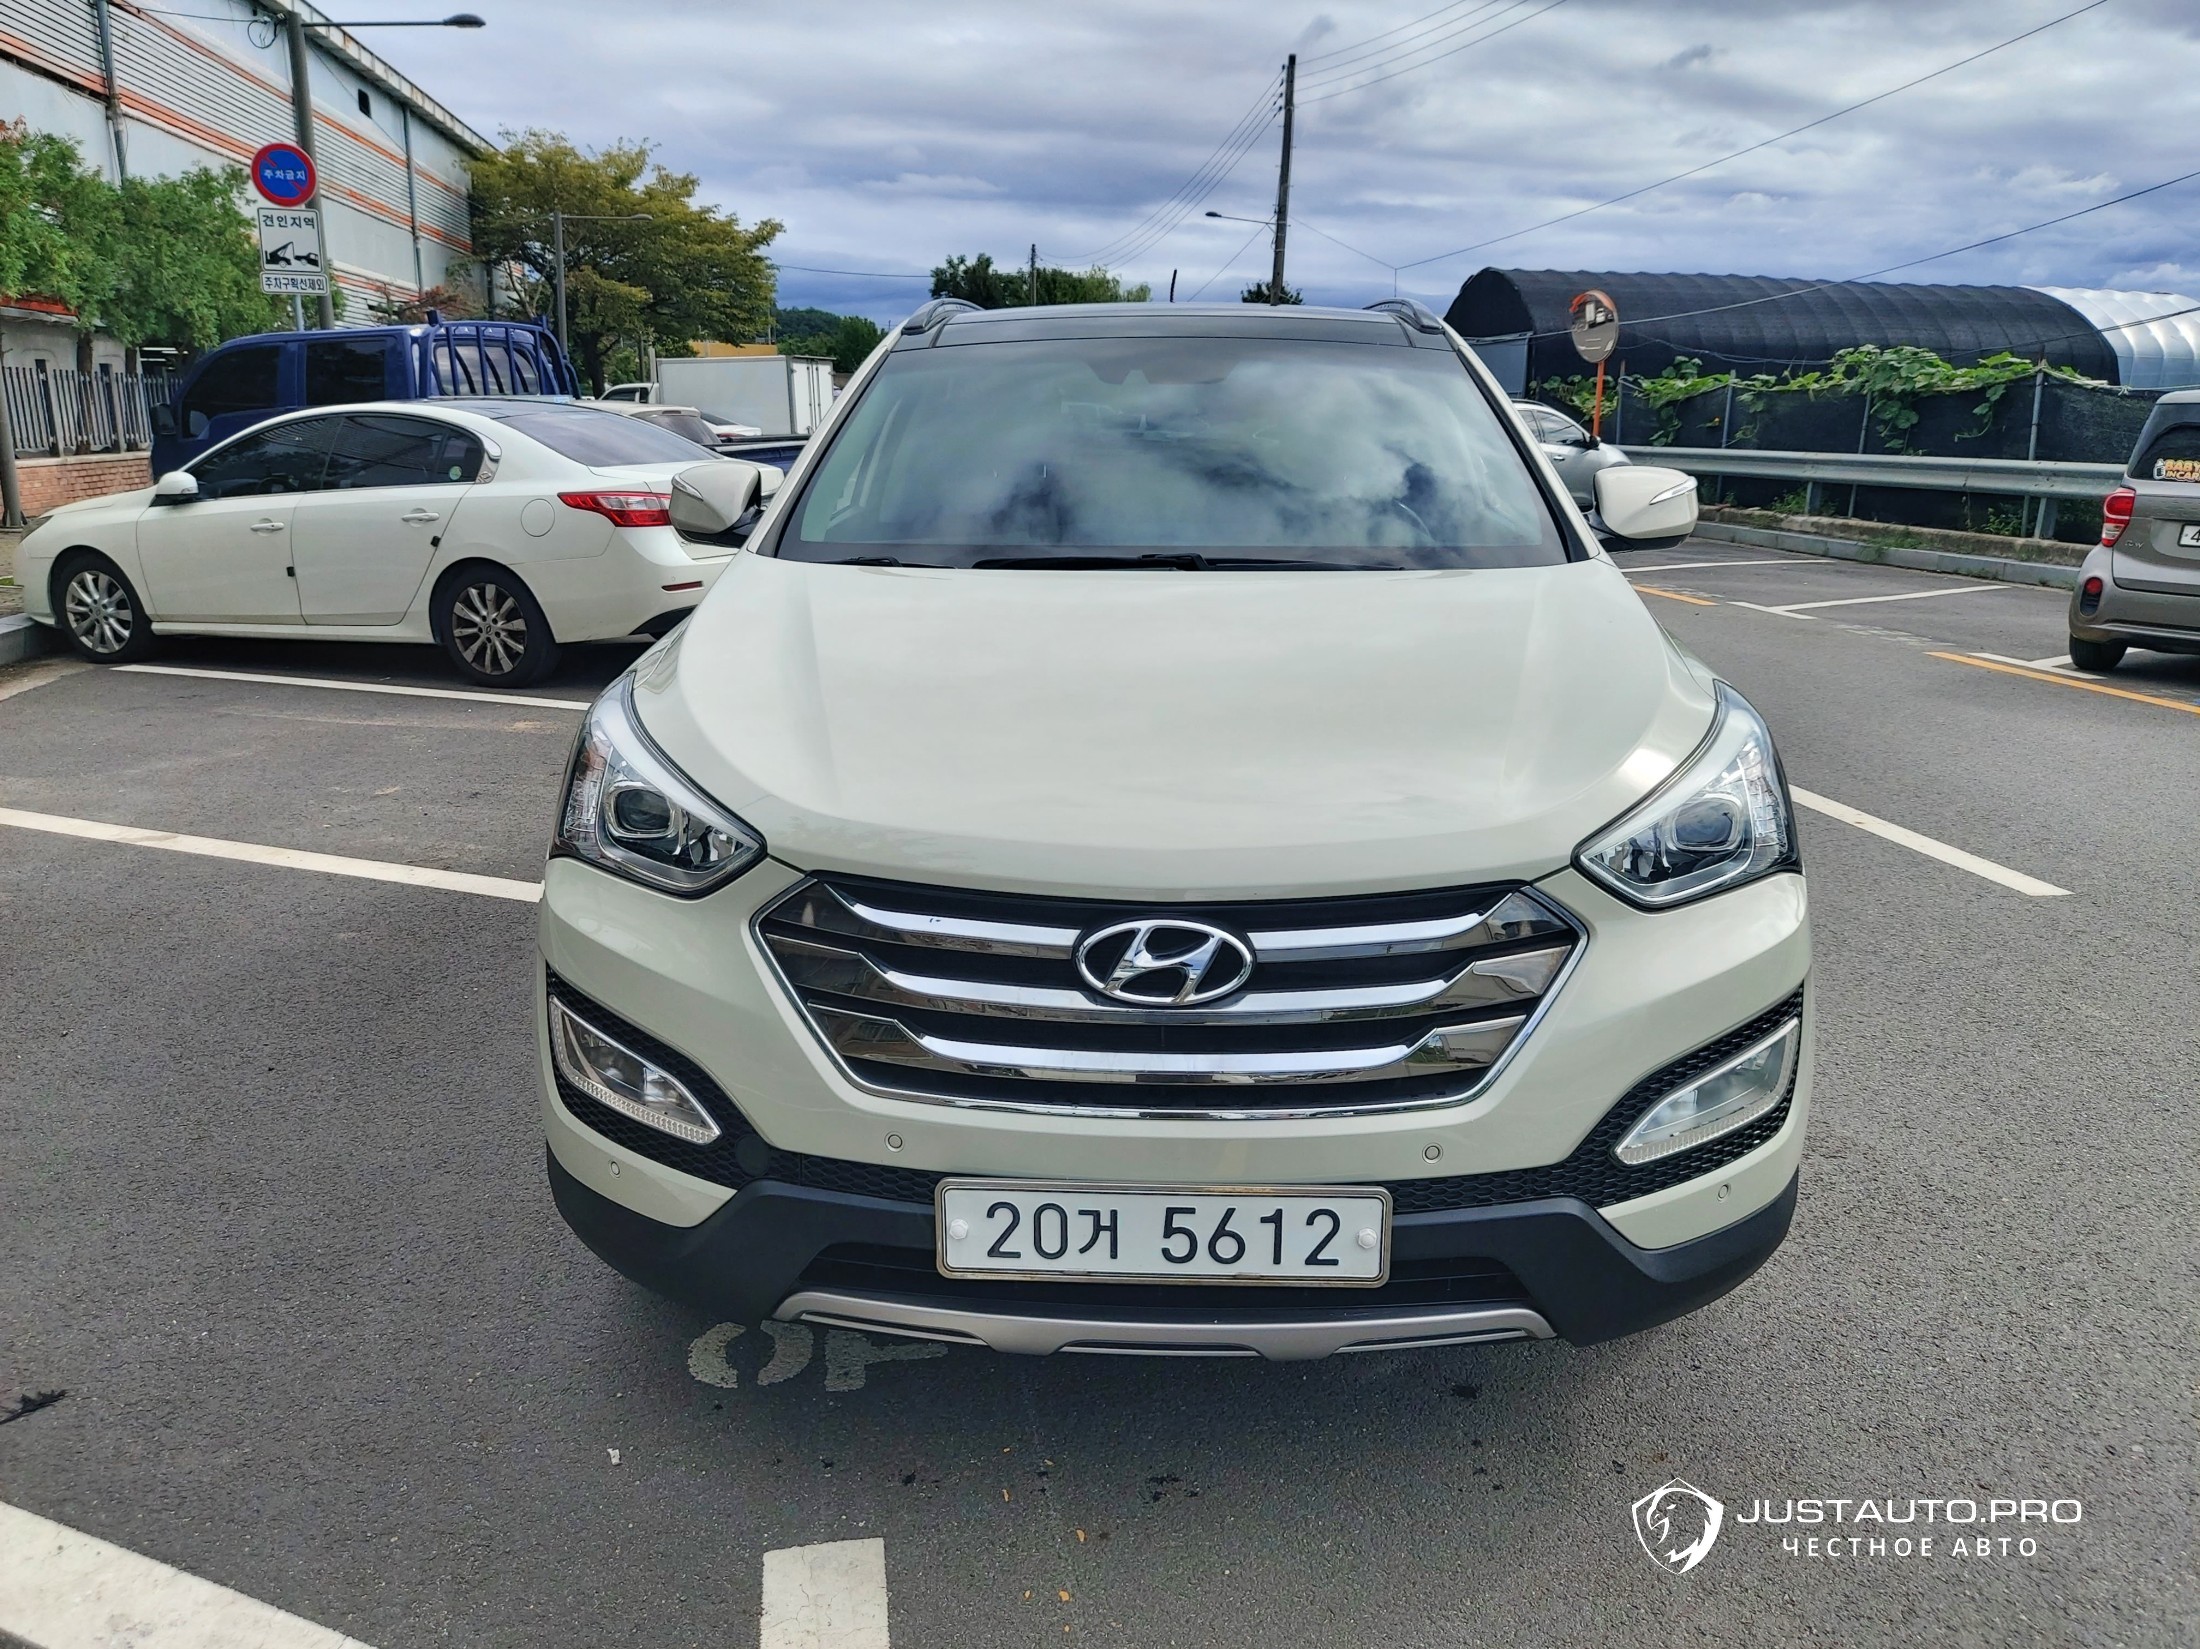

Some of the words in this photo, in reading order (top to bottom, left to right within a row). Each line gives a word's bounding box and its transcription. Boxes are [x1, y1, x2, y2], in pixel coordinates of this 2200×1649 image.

[264, 169, 306, 181] 주차금지
[262, 214, 315, 229] 견인지역
[264, 277, 325, 291] 주차구획선제외
[986, 1201, 1118, 1260] 20거
[1161, 1207, 1341, 1266] 5612
